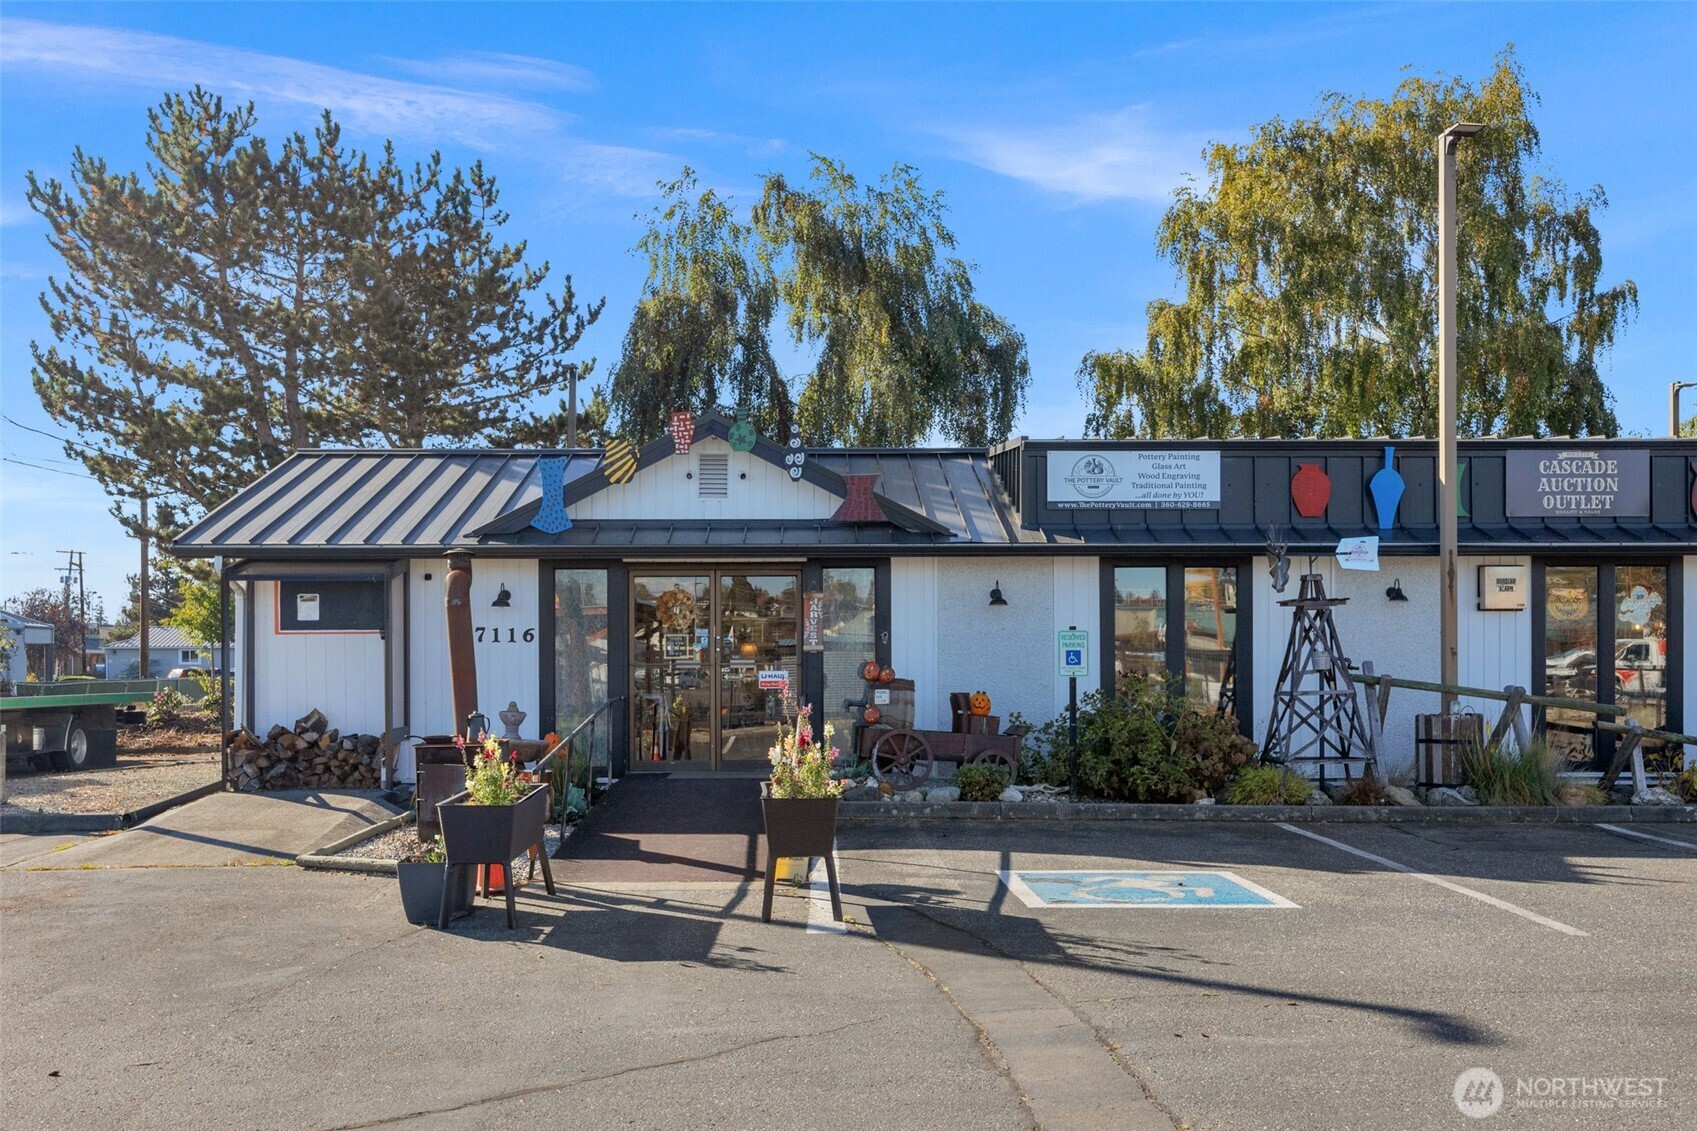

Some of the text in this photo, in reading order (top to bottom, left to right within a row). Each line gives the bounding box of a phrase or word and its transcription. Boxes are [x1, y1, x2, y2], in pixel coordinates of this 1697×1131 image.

[1138, 453, 1201, 461] Pottery Painting
[1538, 460, 1618, 475] CASCADE
[1137, 472, 1201, 481] Wood Engraving
[1175, 482, 1208, 490] Painting
[1537, 477, 1619, 492] AUCTION
[1542, 495, 1614, 509] OUTLET
[475, 626, 535, 643] 7116
